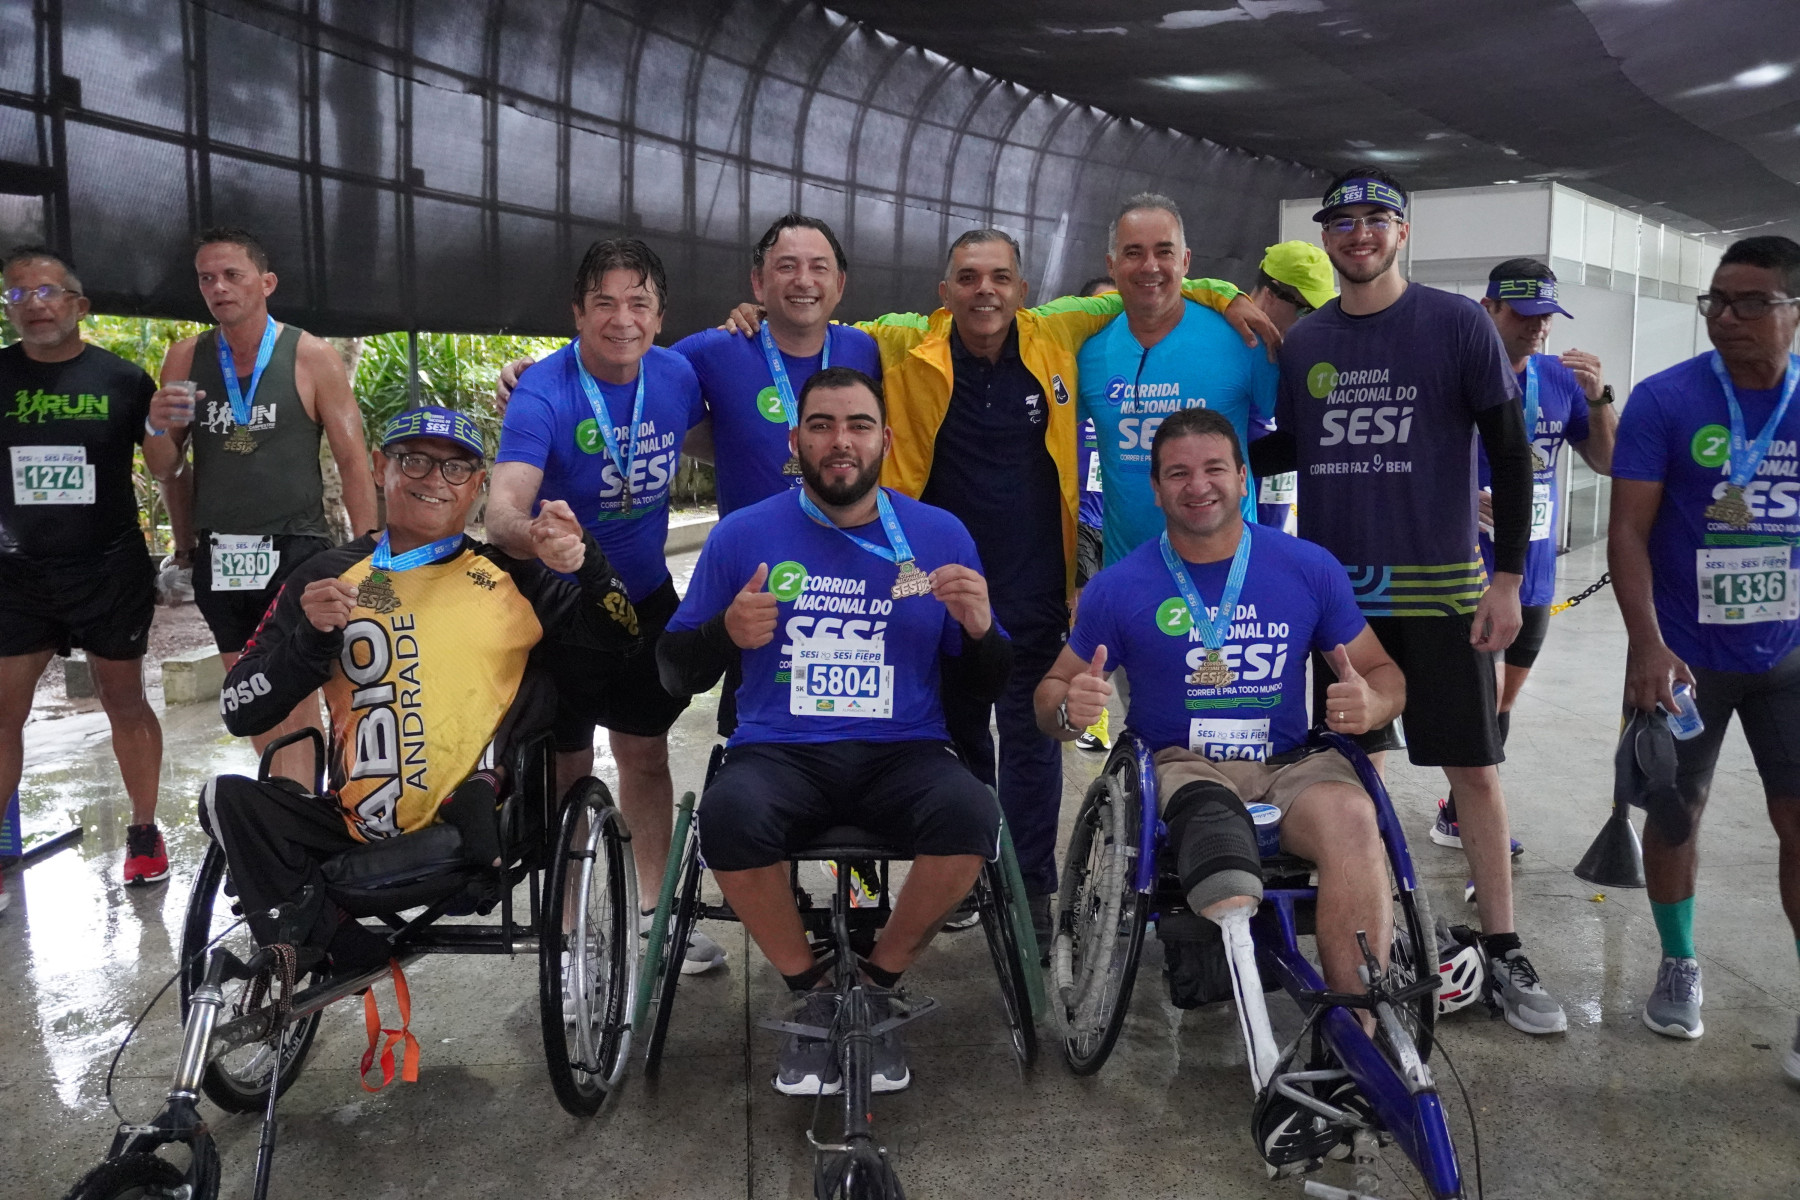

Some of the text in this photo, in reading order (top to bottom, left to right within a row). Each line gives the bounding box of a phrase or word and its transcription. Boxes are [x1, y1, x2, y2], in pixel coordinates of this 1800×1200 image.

[1330, 368, 1389, 387] CORRIDA
[1124, 382, 1180, 399] CORRIDA
[1326, 385, 1418, 405] NACIONAL DO
[40, 394, 109, 414] RUN
[1120, 398, 1182, 415] NACIONAL
[1118, 417, 1164, 451] SE
[1549, 421, 1563, 434] DO
[662, 431, 675, 449] DO
[27, 466, 83, 489] 1274
[1309, 462, 1349, 476] CORRER
[1350, 462, 1370, 473] FAZ
[1386, 461, 1412, 473] BEM
[222, 553, 268, 575] 1280
[800, 575, 866, 595] CORRIDA
[1719, 572, 1784, 604] 1336
[793, 594, 893, 616] NACIONAL DO
[1267, 622, 1290, 639] DO
[811, 666, 877, 696] 5804
[1187, 682, 1283, 697] CORRER E PRA TODO MUNDO
[391, 613, 429, 791] ANDRADE
[340, 617, 404, 842] ABIO
